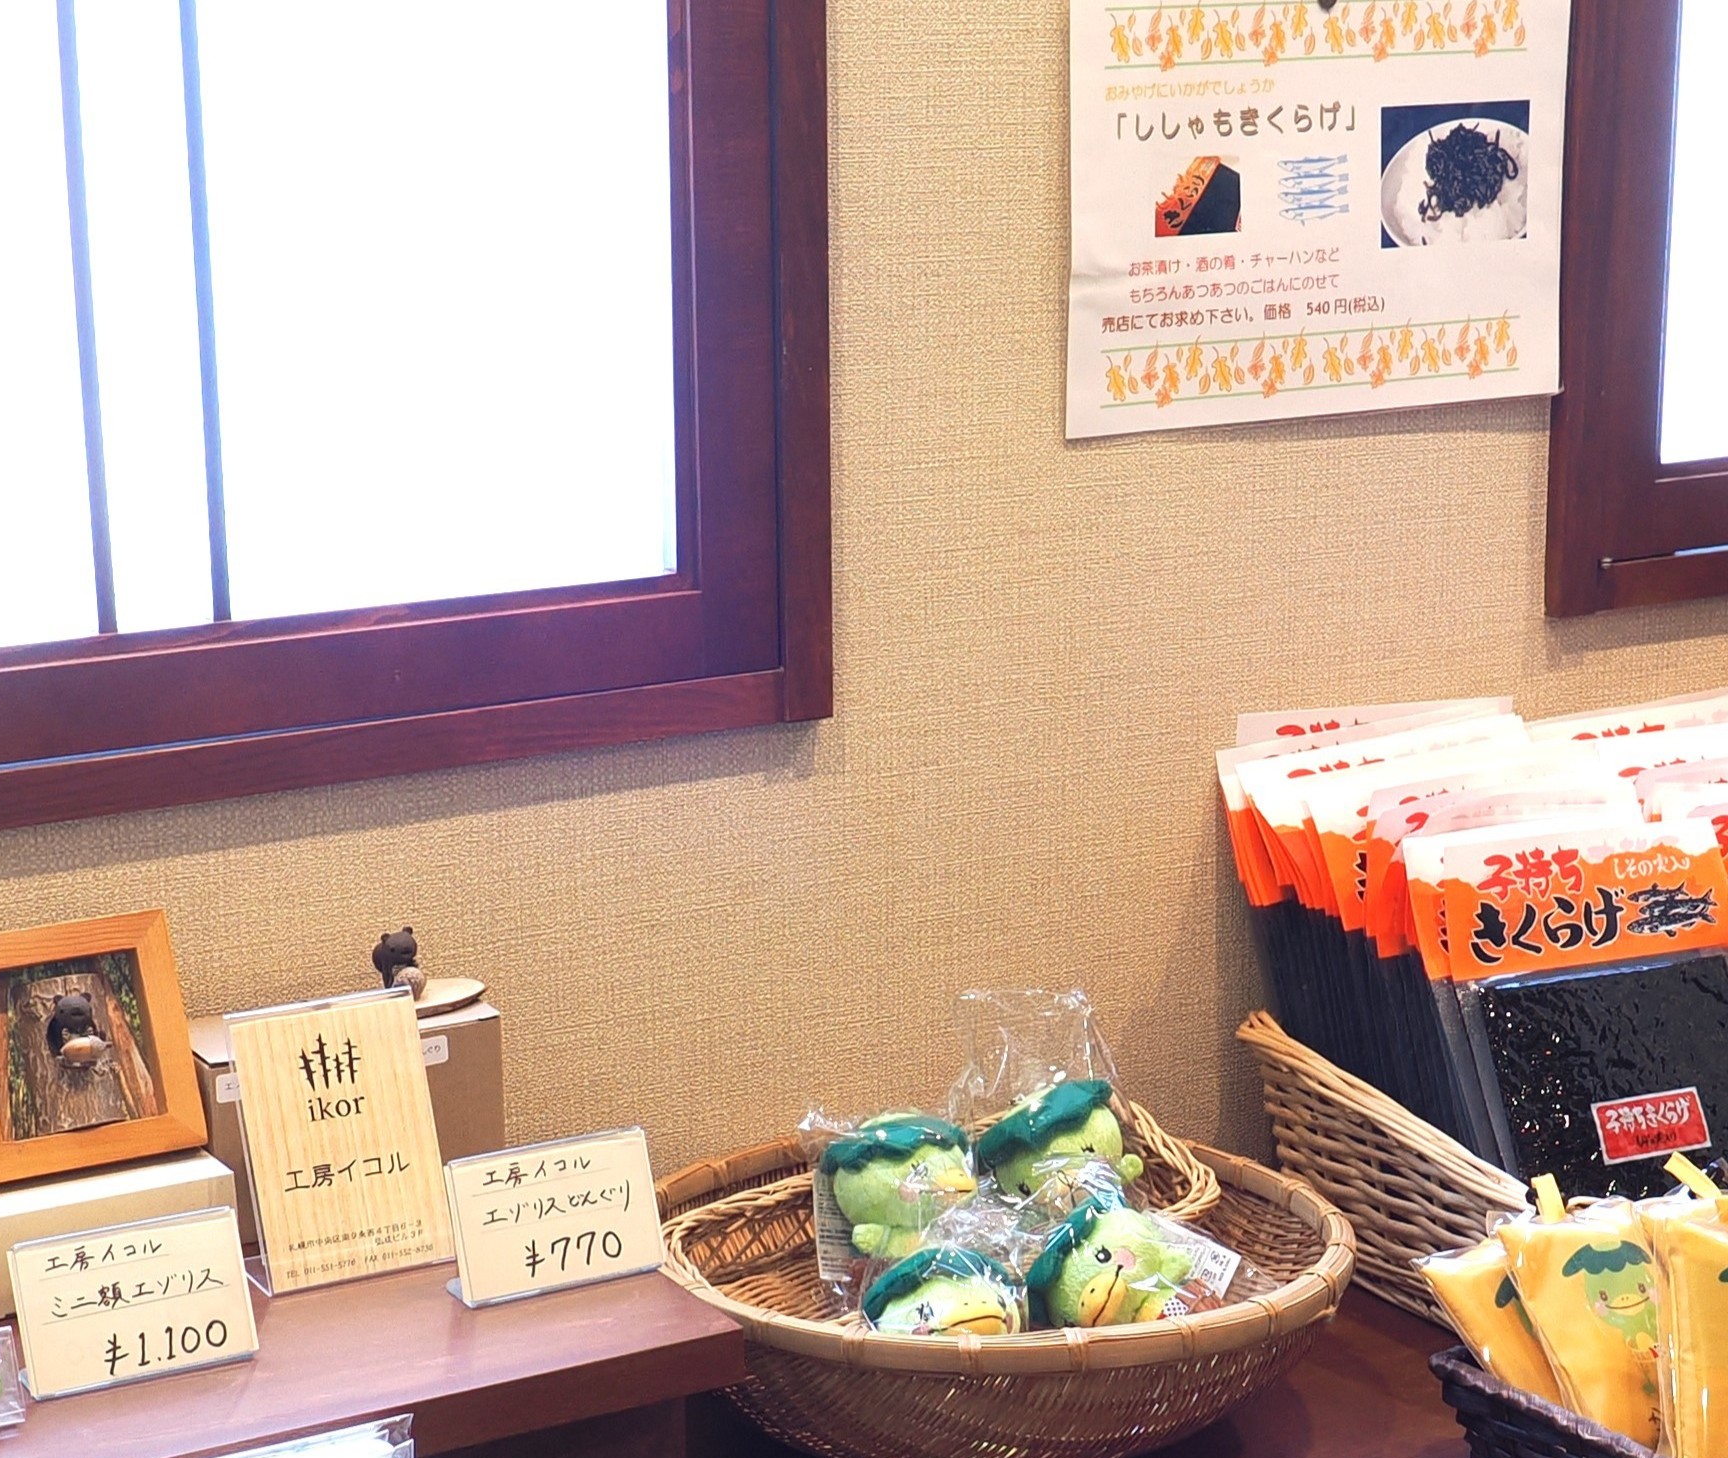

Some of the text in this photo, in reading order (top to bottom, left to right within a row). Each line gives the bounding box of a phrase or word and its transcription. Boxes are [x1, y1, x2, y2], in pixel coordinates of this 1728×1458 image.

[1105, 77, 1275, 101] おみやげにいかがでしょうか
[1117, 102, 1357, 141] 「ししゃもきくらげ」
[1129, 247, 1340, 277] お茶漬け・酒の肴・チャーハンなど
[1129, 273, 1340, 303] もちろんあつあつのごはんにのせて
[1476, 845, 1584, 901] 子持ち
[1470, 885, 1626, 965] きくらげ
[308, 1095, 365, 1122] ikor
[1605, 1095, 1692, 1135] 子持ちきくらげ
[284, 1151, 411, 1192] 工房イコル
[482, 1155, 591, 1187] 工房イコル
[482, 1179, 631, 1226] エゾリスどんぐり
[45, 1239, 162, 1272] 工房イコル
[525, 1230, 623, 1278] ¥770
[50, 1266, 224, 1318] ミニ額エゾリス
